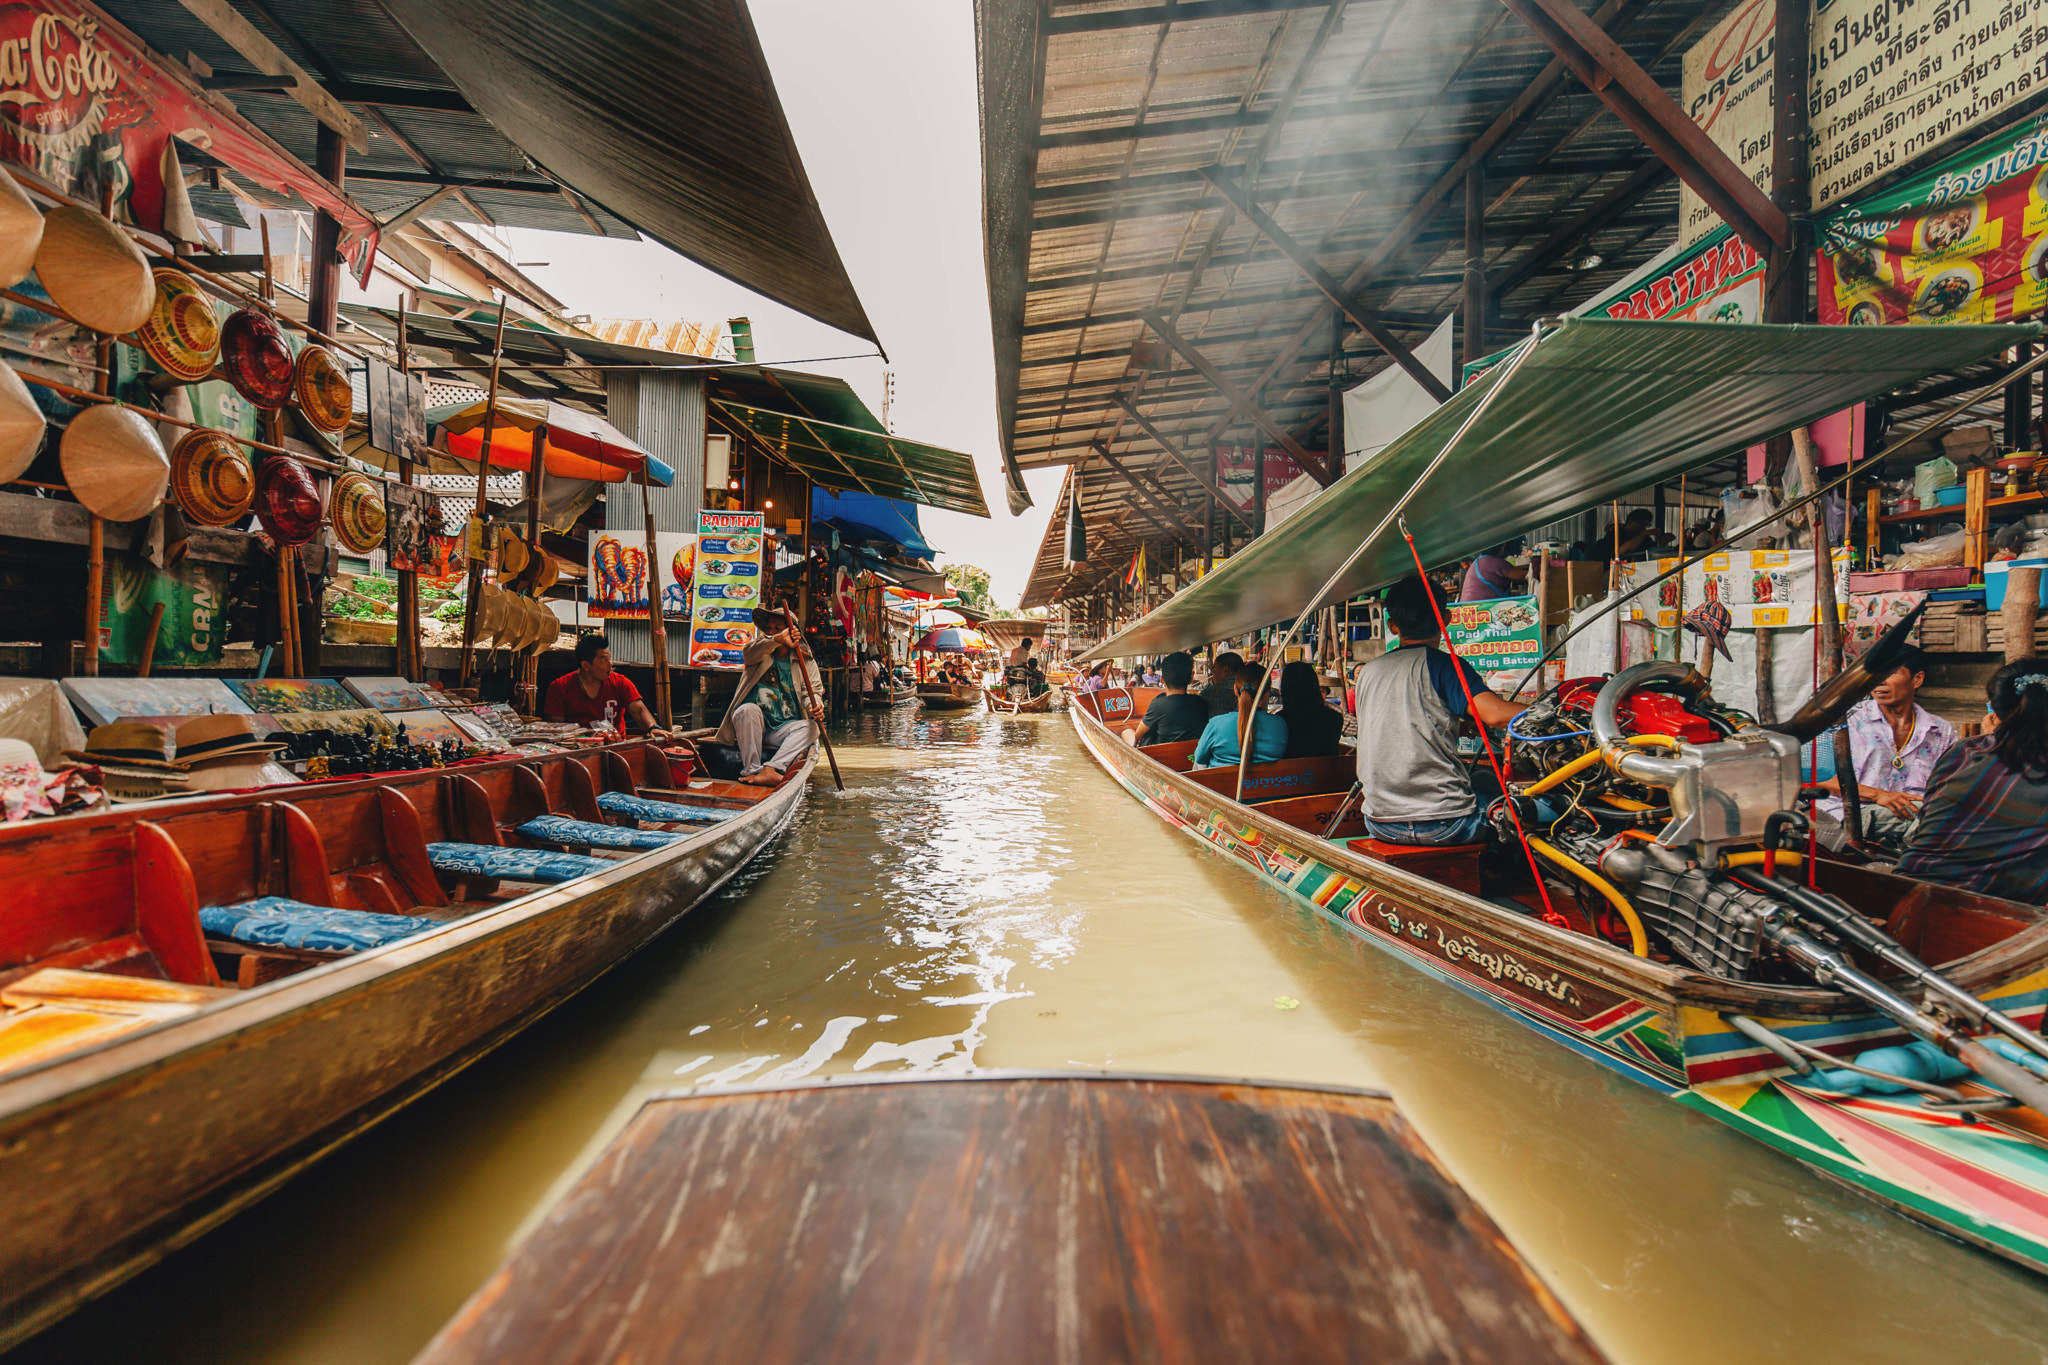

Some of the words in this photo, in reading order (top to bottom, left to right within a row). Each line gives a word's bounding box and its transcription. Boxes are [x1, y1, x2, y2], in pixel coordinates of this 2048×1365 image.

[0, 12, 119, 100] a-Cola
[701, 514, 761, 528] PADTHAI
[1456, 629, 1481, 640] Pad
[1484, 627, 1512, 638] Thai
[1478, 658, 1500, 668] Egg
[1502, 656, 1541, 666] Batter
[1104, 698, 1117, 713] K
